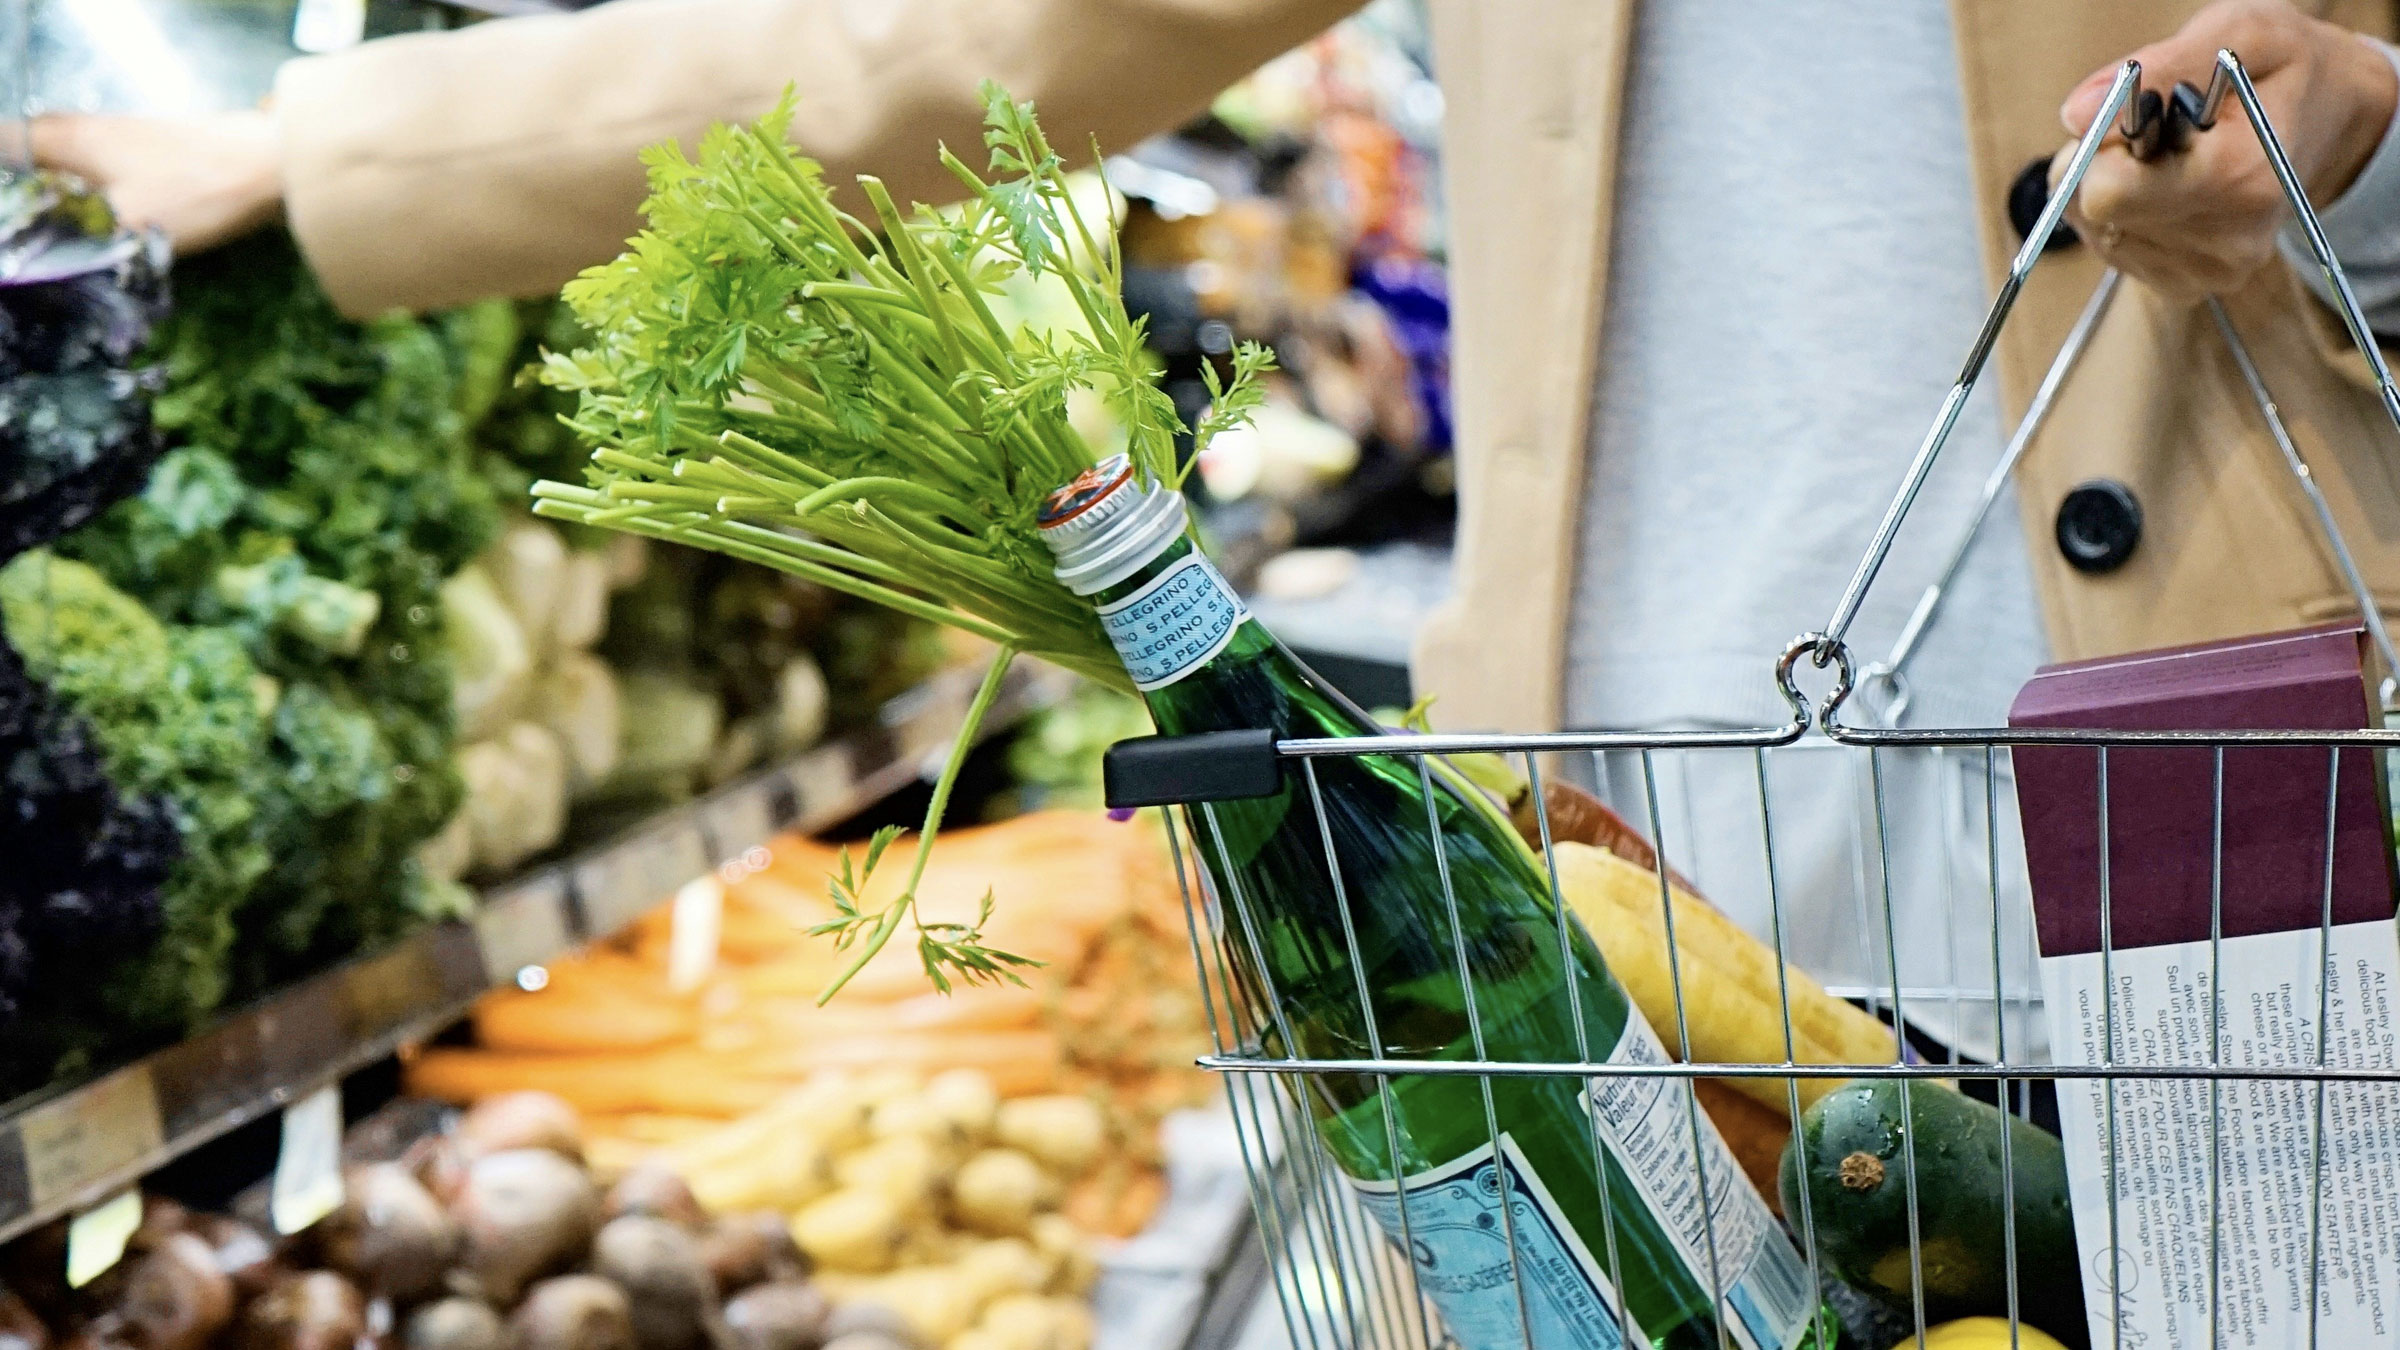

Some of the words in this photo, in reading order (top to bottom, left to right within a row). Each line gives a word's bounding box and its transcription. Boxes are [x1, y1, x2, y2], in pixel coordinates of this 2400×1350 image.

[1111, 578, 1188, 628] ELLEGRINO
[2167, 965, 2180, 993] Seul
[2197, 971, 2208, 987] de
[2357, 959, 2374, 1018] delicious
[2374, 971, 2385, 983] At
[2078, 989, 2090, 1018] vous
[2121, 976, 2137, 1031] Délicieux
[2171, 997, 2181, 1012] un
[2184, 984, 2195, 1013] avec
[2266, 992, 2277, 1010] but
[2280, 983, 2293, 1017] these
[2332, 998, 2343, 1006] &
[2373, 988, 2391, 1029] Lesley
[2251, 992, 2266, 1037] cheese
[2299, 1017, 2310, 1026] A
[2334, 1012, 2346, 1031] her
[2083, 1022, 2092, 1037] ne
[2171, 1017, 2189, 1060] produit
[2187, 1017, 2200, 1045] soin,
[2267, 1016, 2282, 1047] really
[2283, 1022, 2298, 1064] unique
[2351, 1029, 2361, 1049] are
[2365, 1019, 2378, 1048] food.
[2129, 1037, 2138, 1051] au
[2257, 1042, 2266, 1054] or
[2337, 1037, 2350, 1068] team
[2193, 1051, 2202, 1066] en
[2091, 1092, 2105, 1118] plus
[2121, 1091, 2132, 1106] de
[2165, 1080, 2182, 1123] pouvait
[2248, 1080, 2260, 1106] food
[2278, 1089, 2292, 1123] when
[2359, 1092, 2372, 1117] with
[1604, 1088, 1638, 1128] Valeur
[2138, 1107, 2148, 1127] ces
[2152, 1100, 2168, 1141] POUR
[2329, 1091, 2343, 1135] scratch
[2347, 1106, 2358, 1125] the
[2374, 1095, 2391, 1147] fabulous
[2096, 1123, 2108, 1150] vous
[2122, 1110, 2140, 1171] trempette,
[2184, 1113, 2203, 1162] fabriqué
[2230, 1109, 2245, 1146] Foods
[2253, 1124, 2263, 1143] are
[2268, 1122, 2280, 1141] We
[2299, 1125, 2308, 1144] are
[2363, 1121, 2375, 1148] care
[2173, 1128, 2190, 1182] satisfaire
[2271, 1146, 2281, 1166] are
[2281, 1127, 2298, 1169] topped
[2334, 1139, 2348, 1172] using
[2347, 1130, 2362, 1155] only
[2138, 1132, 2159, 1194] craquelins
[2158, 1144, 2172, 1172] CES
[2219, 1136, 2235, 1186] fabuleux
[2235, 1150, 2250, 1185] adore
[2256, 1148, 2267, 1174] sure
[2350, 1160, 2363, 1183] way
[2367, 1153, 2377, 1163] in
[2379, 1152, 2395, 1188] crisps
[2133, 1176, 2144, 1191] de
[2162, 1178, 2177, 1208] FINS
[2193, 1167, 2205, 1196] avec
[2259, 1180, 2271, 1200] you
[2290, 1173, 2303, 1197] with
[2340, 1176, 2350, 1195] our
[2356, 1187, 2367, 1199] to
[2369, 1168, 2382, 1200] small
[2179, 1187, 2196, 1227] Lesley
[2275, 1170, 2291, 1222] addicted
[2387, 1193, 2399, 1219] from
[2133, 1196, 2151, 1246] fromage
[2151, 1199, 2163, 1224] sont
[2198, 1200, 2211, 1221] des
[2222, 1191, 2243, 1254] craquelins
[2238, 1190, 2258, 1244] fabriquer
[2265, 1205, 2277, 1223] will
[2291, 1202, 2305, 1228] your
[2343, 1200, 2357, 1233] finest
[2358, 1203, 2372, 1237] make
[2187, 1231, 2197, 1242] et
[2268, 1229, 2279, 1243] be
[2282, 1227, 2292, 1238] to
[2373, 1205, 2390, 1256] batches.
[2143, 1251, 2152, 1266] ou
[2155, 1229, 2173, 1297] irrésistibles
[2167, 1213, 2190, 1303] CRAQUELINS
[2189, 1247, 2199, 1268] son
[2249, 1249, 2259, 1260] et
[2285, 1243, 2296, 1263] this
[2223, 1275, 2234, 1290] de
[2235, 1259, 2247, 1284] sont
[2251, 1264, 2262, 1293] vous
[2317, 1259, 2329, 1286] their
[2346, 1237, 2367, 1306] ingredients.
[2362, 1253, 2378, 1284] great
[2191, 1273, 2208, 1316] équipe.
[2285, 1268, 2301, 1312] yummy
[2320, 1291, 2331, 1316] own
[2223, 1295, 2240, 1335] Lesley
[2235, 1289, 2257, 1345] fabriqués
[2256, 1297, 2269, 1324] offrir
[2367, 1288, 2386, 1335] product
